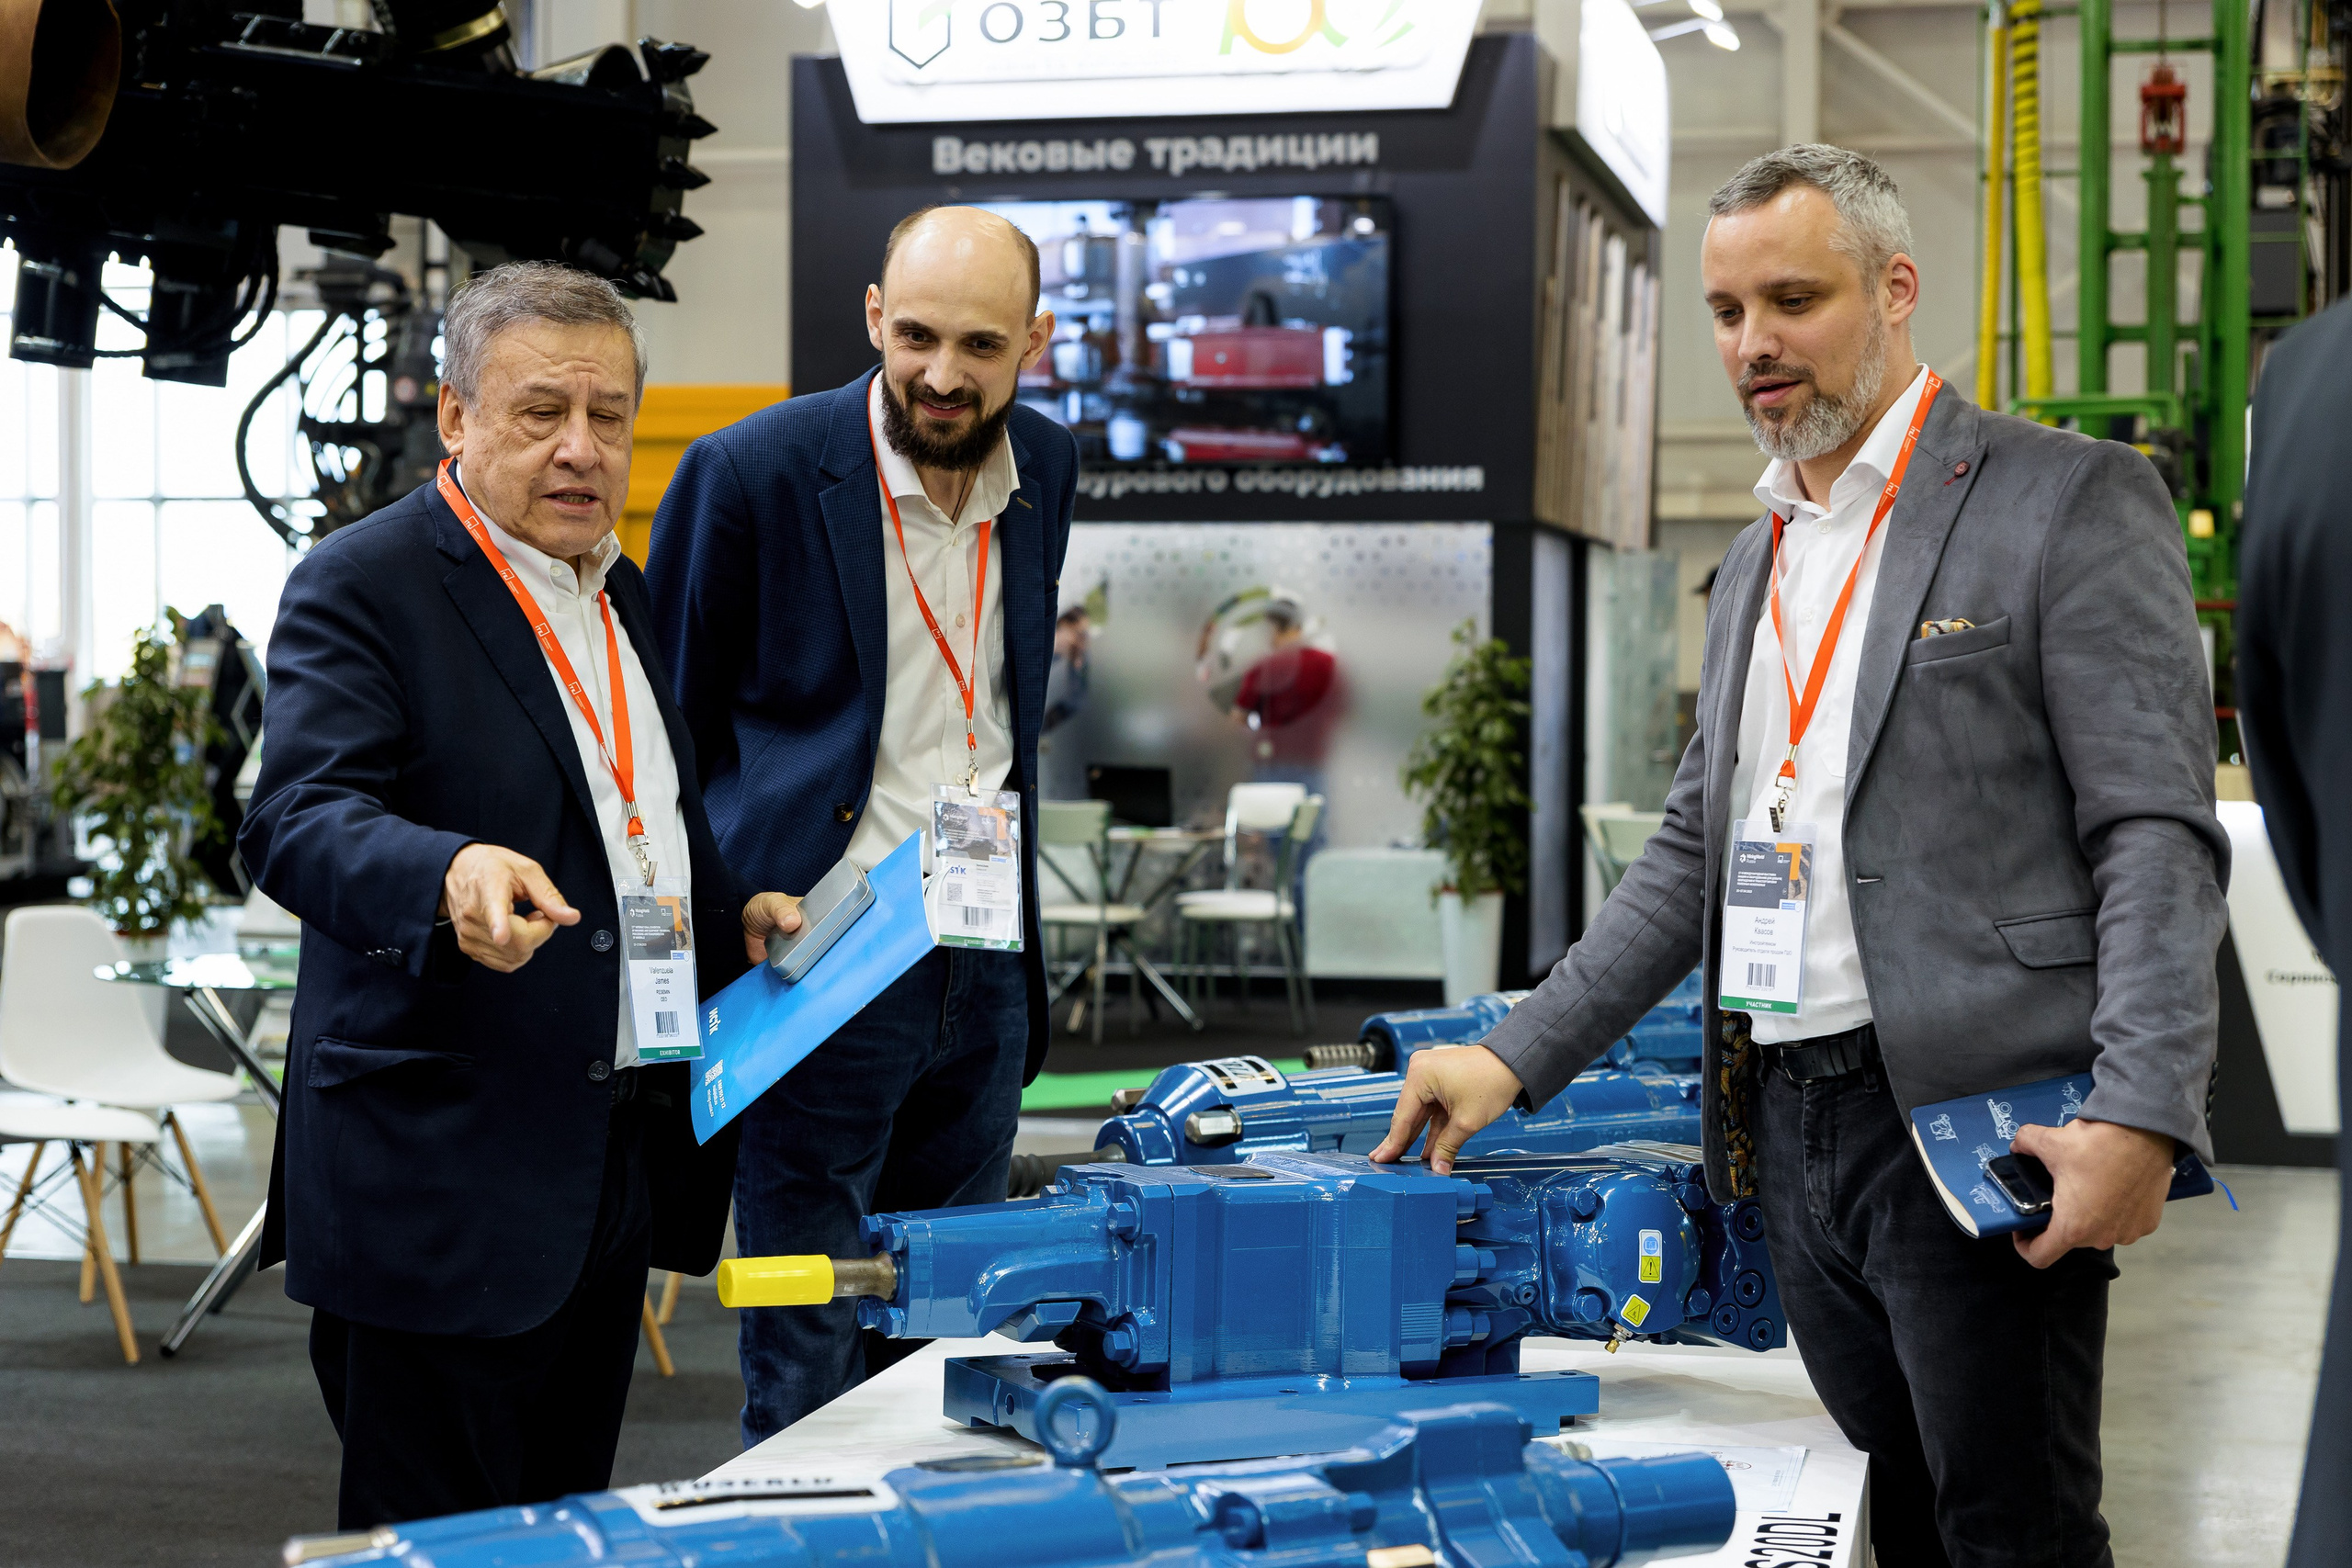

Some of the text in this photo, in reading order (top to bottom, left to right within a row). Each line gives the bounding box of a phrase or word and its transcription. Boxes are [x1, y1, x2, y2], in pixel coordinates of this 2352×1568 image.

[979, 0, 1173, 43] ОЗБТ
[933, 133, 1377, 175] Вековые традиции
[1234, 466, 1486, 498] оборудования
[1754, 927, 1773, 935] Квасов
[1755, 916, 1775, 925] Андрей
[1746, 1000, 1772, 1010] УЧАСТНИК
